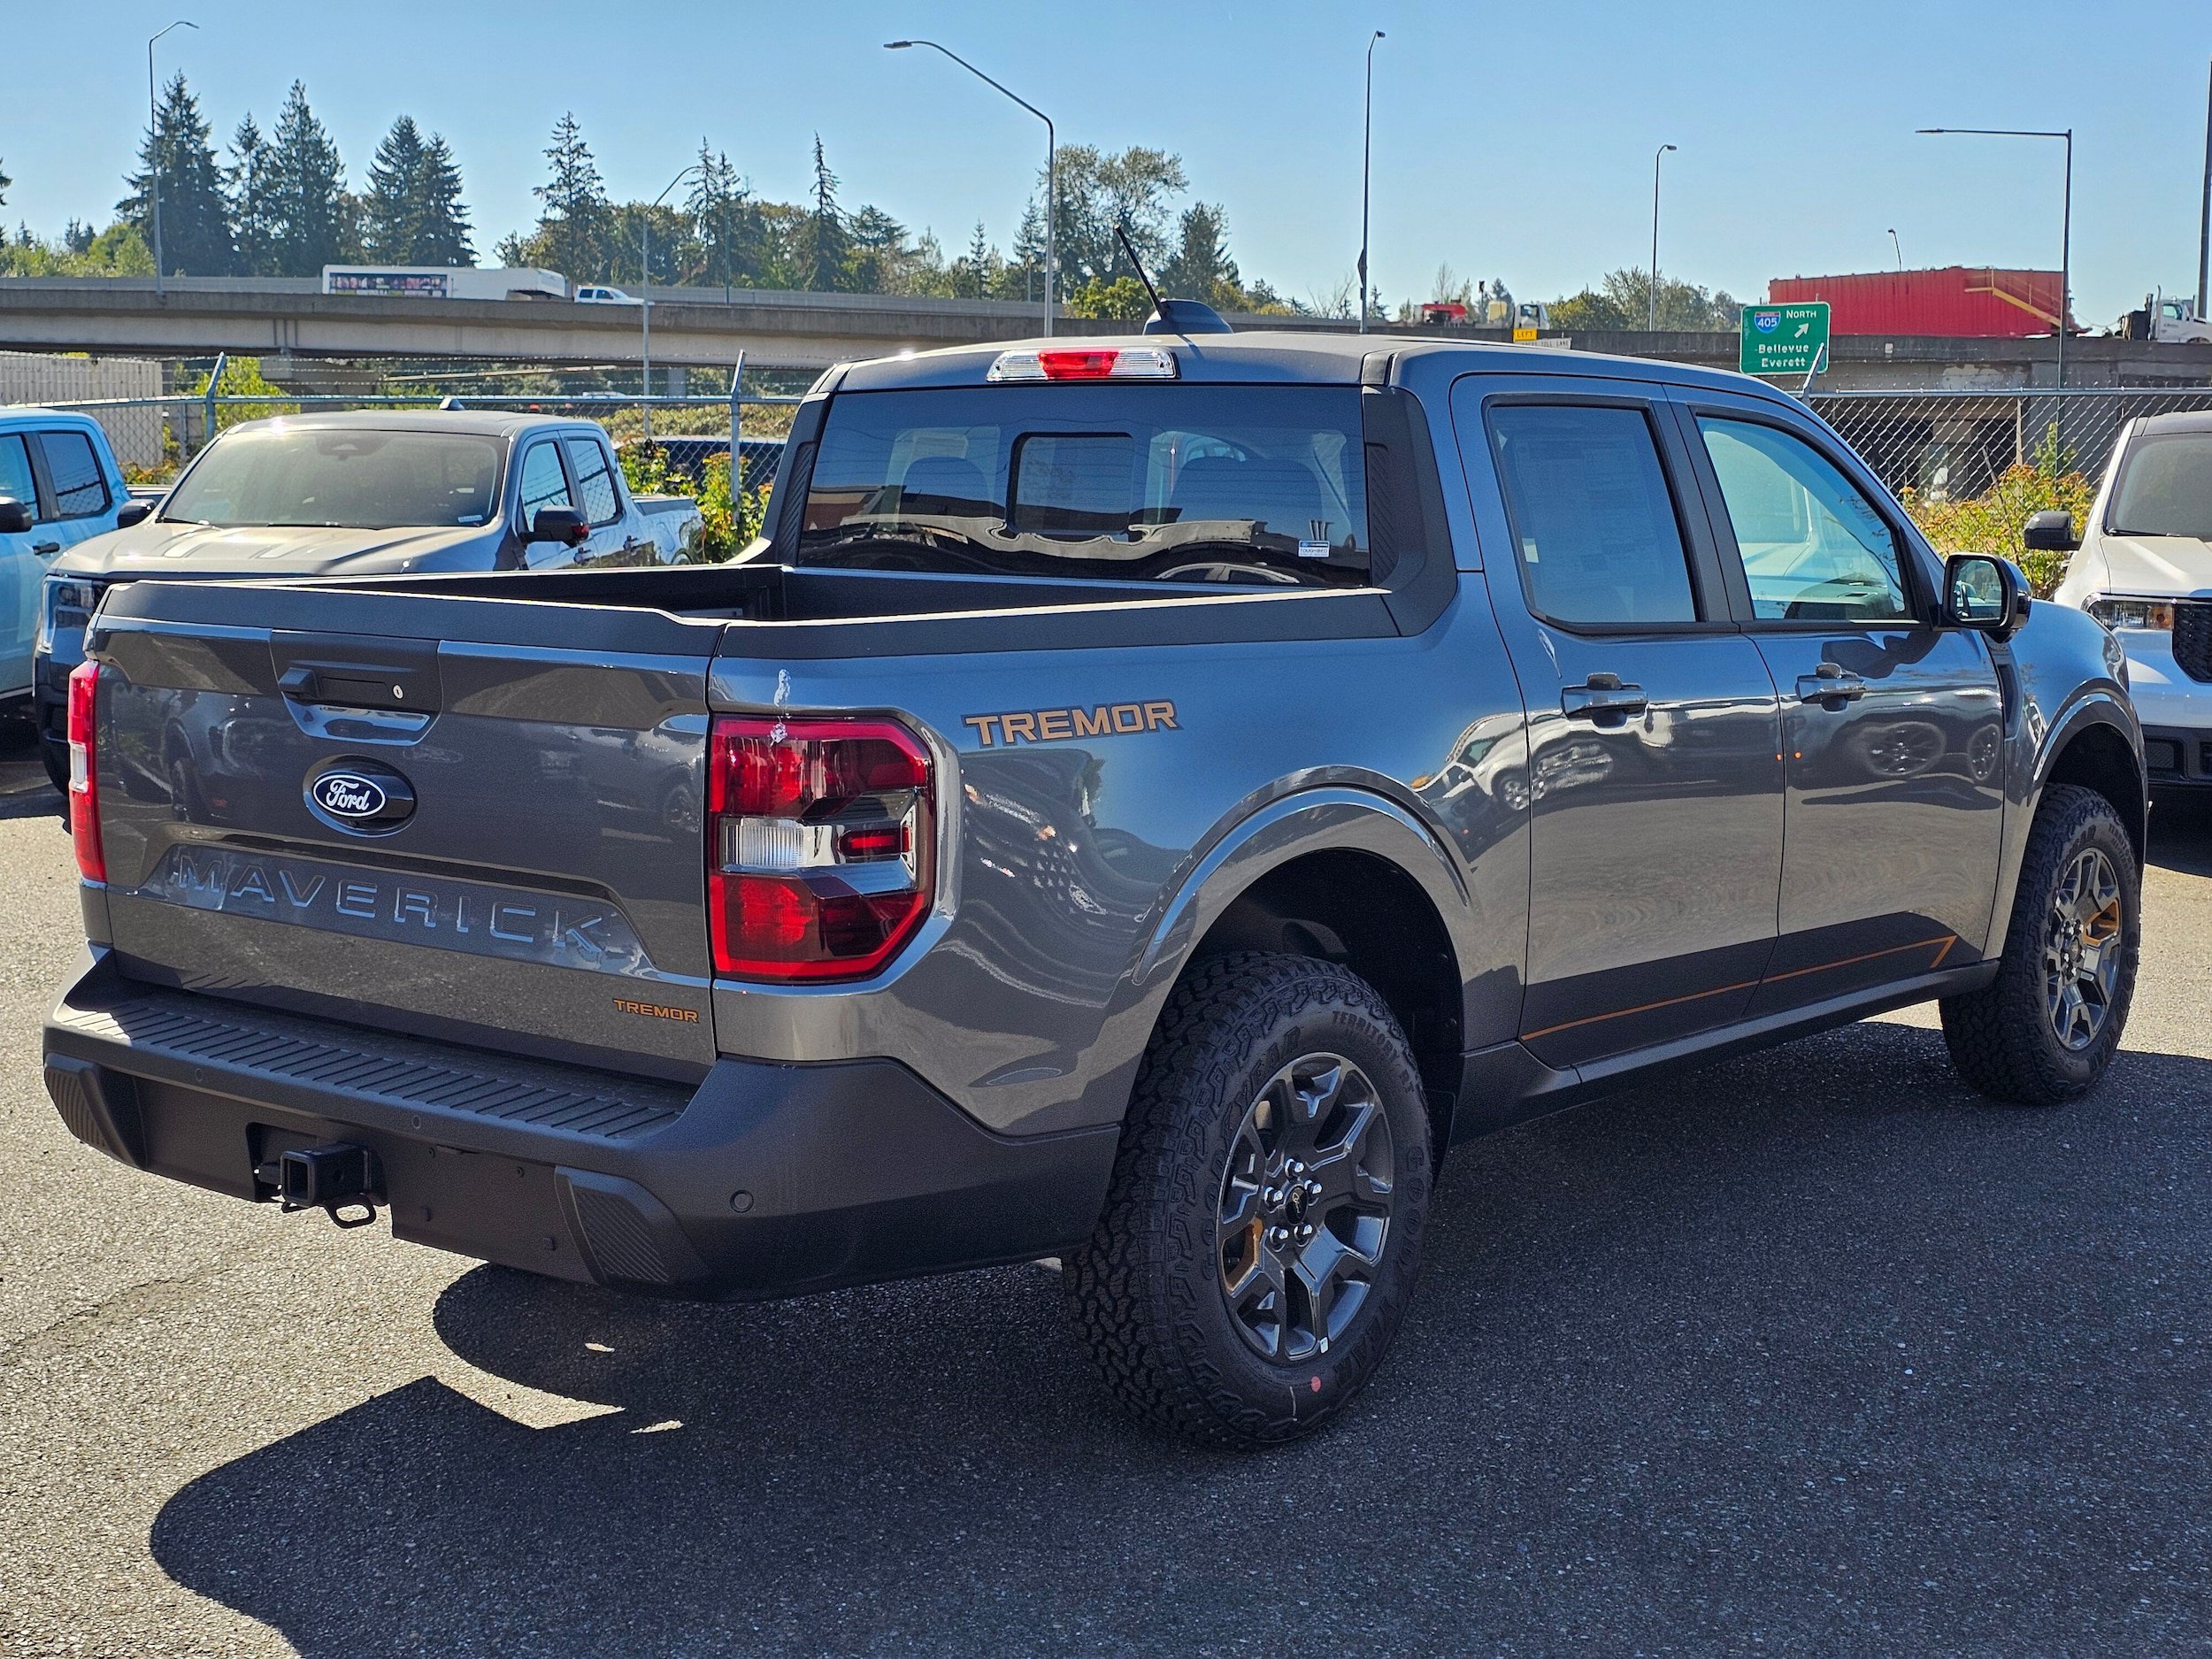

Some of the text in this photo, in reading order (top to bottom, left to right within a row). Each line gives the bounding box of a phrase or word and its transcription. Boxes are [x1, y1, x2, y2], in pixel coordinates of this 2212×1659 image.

[1757, 317, 1778, 327] 405
[1786, 310, 1816, 319] NORTH
[1758, 343, 1809, 354] Bellevue
[1761, 357, 1806, 367] Everett
[963, 700, 1181, 748] TREMOR
[326, 779, 370, 811] Ford
[177, 855, 603, 954] MAVERICK
[612, 998, 700, 1024] TREMOR
[1333, 1010, 1399, 1060] TERRITORY
